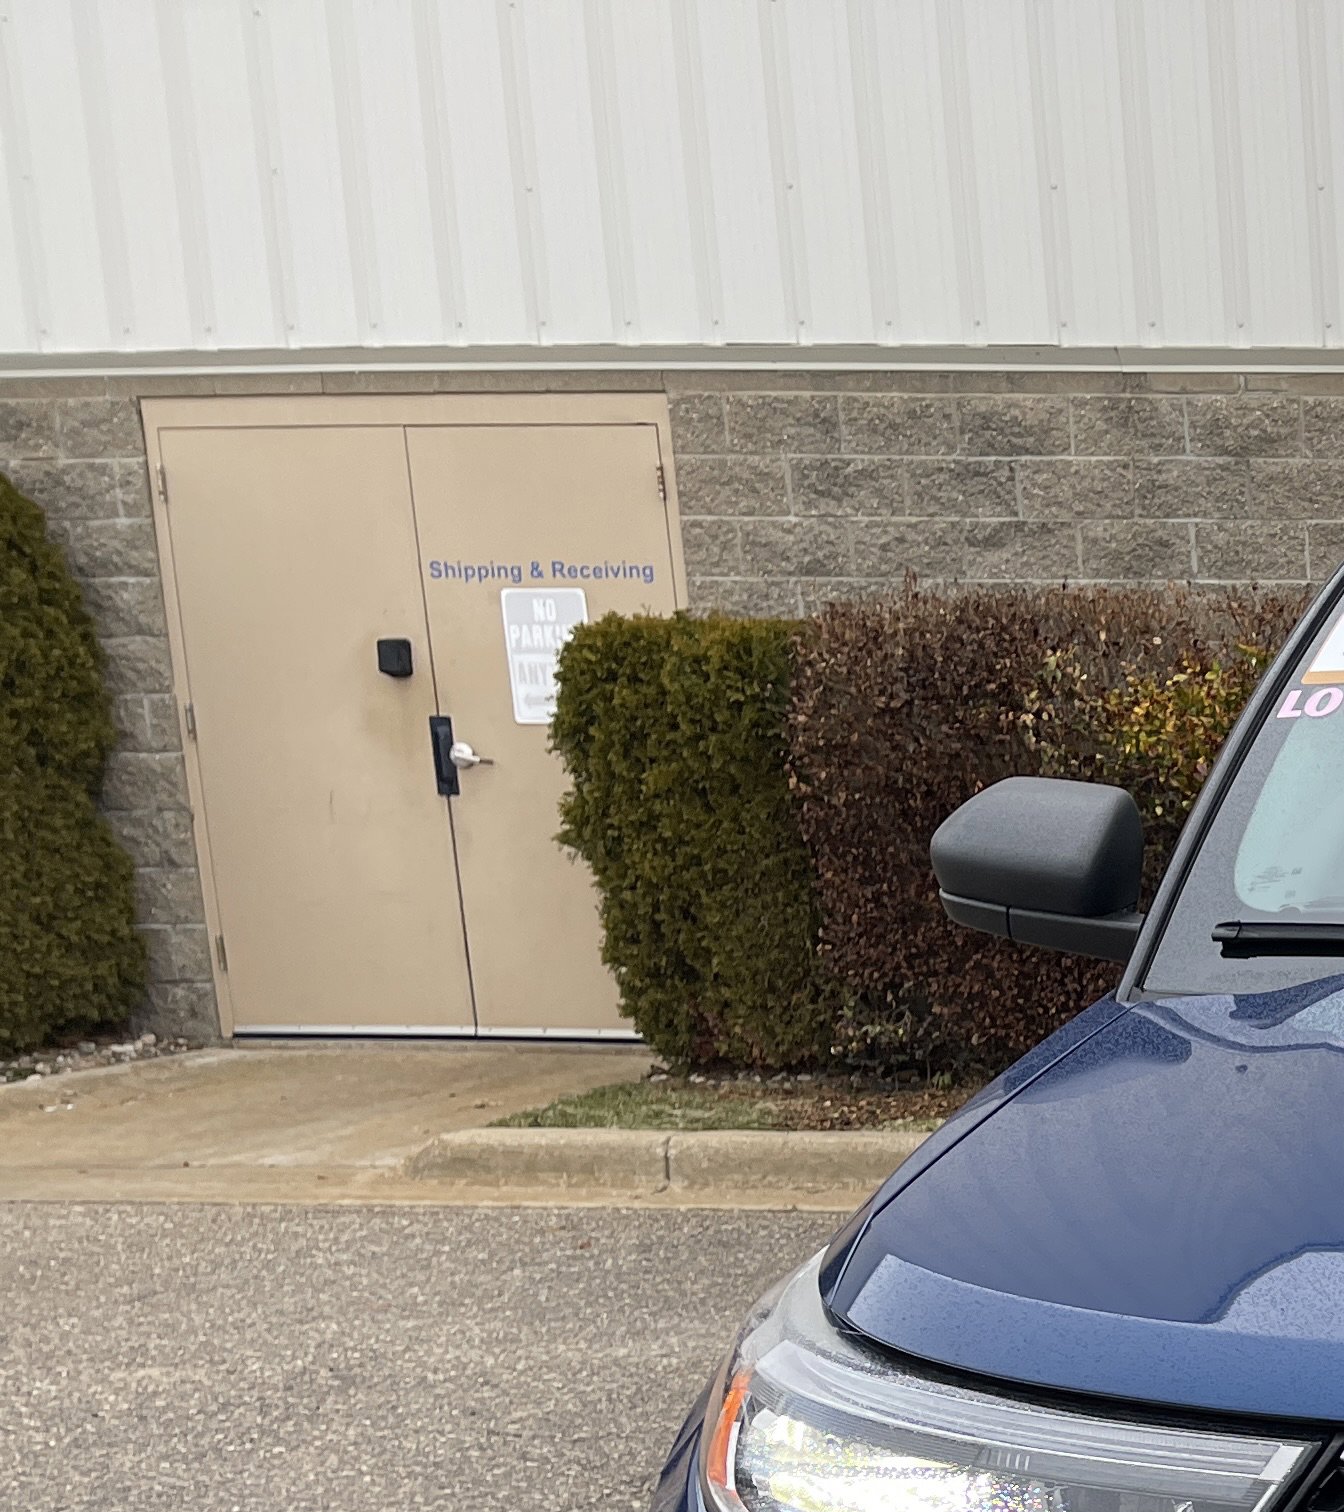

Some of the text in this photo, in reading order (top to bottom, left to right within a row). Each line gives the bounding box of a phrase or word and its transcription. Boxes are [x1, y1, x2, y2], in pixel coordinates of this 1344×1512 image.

[429, 560, 654, 583] Shipping & Receiving
[532, 598, 557, 622] NO
